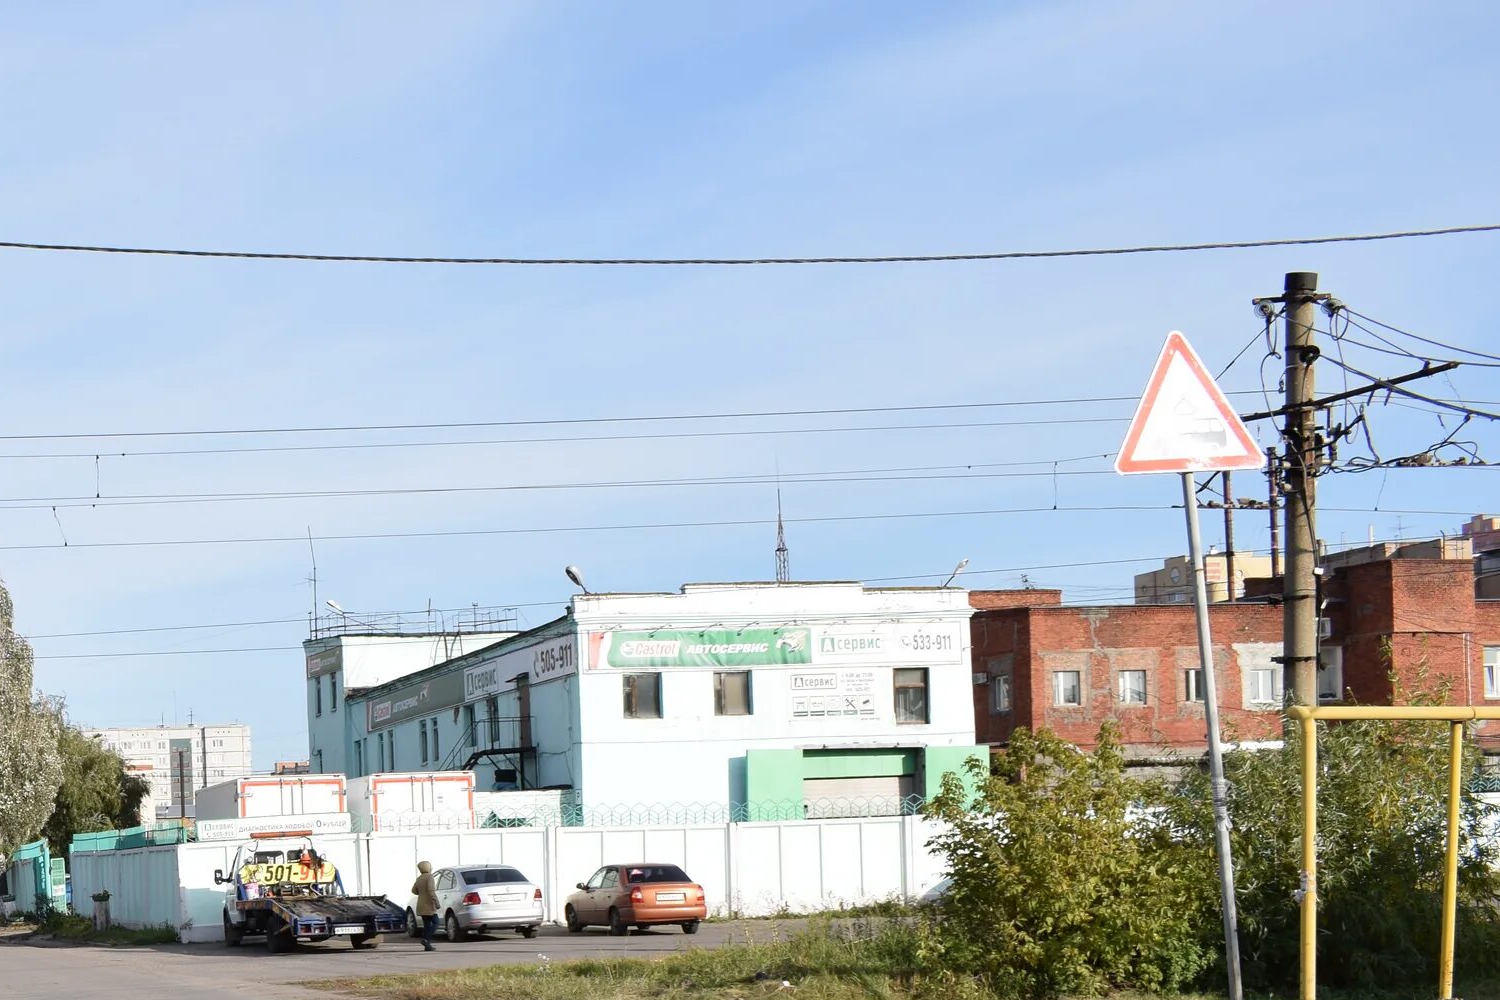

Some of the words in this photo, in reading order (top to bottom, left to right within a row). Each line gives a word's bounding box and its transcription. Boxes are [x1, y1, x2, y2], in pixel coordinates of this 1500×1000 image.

[635, 642, 677, 656] Castrol
[686, 642, 769, 655] АВТОСЕРВИС
[837, 637, 881, 652] сервис
[912, 635, 952, 650] 533-911
[541, 643, 573, 674] 505-911
[474, 669, 496, 692] сервис
[804, 678, 834, 688] сервис
[238, 825, 283, 833] ДИАГНОСТИКА
[316, 820, 322, 828] 0
